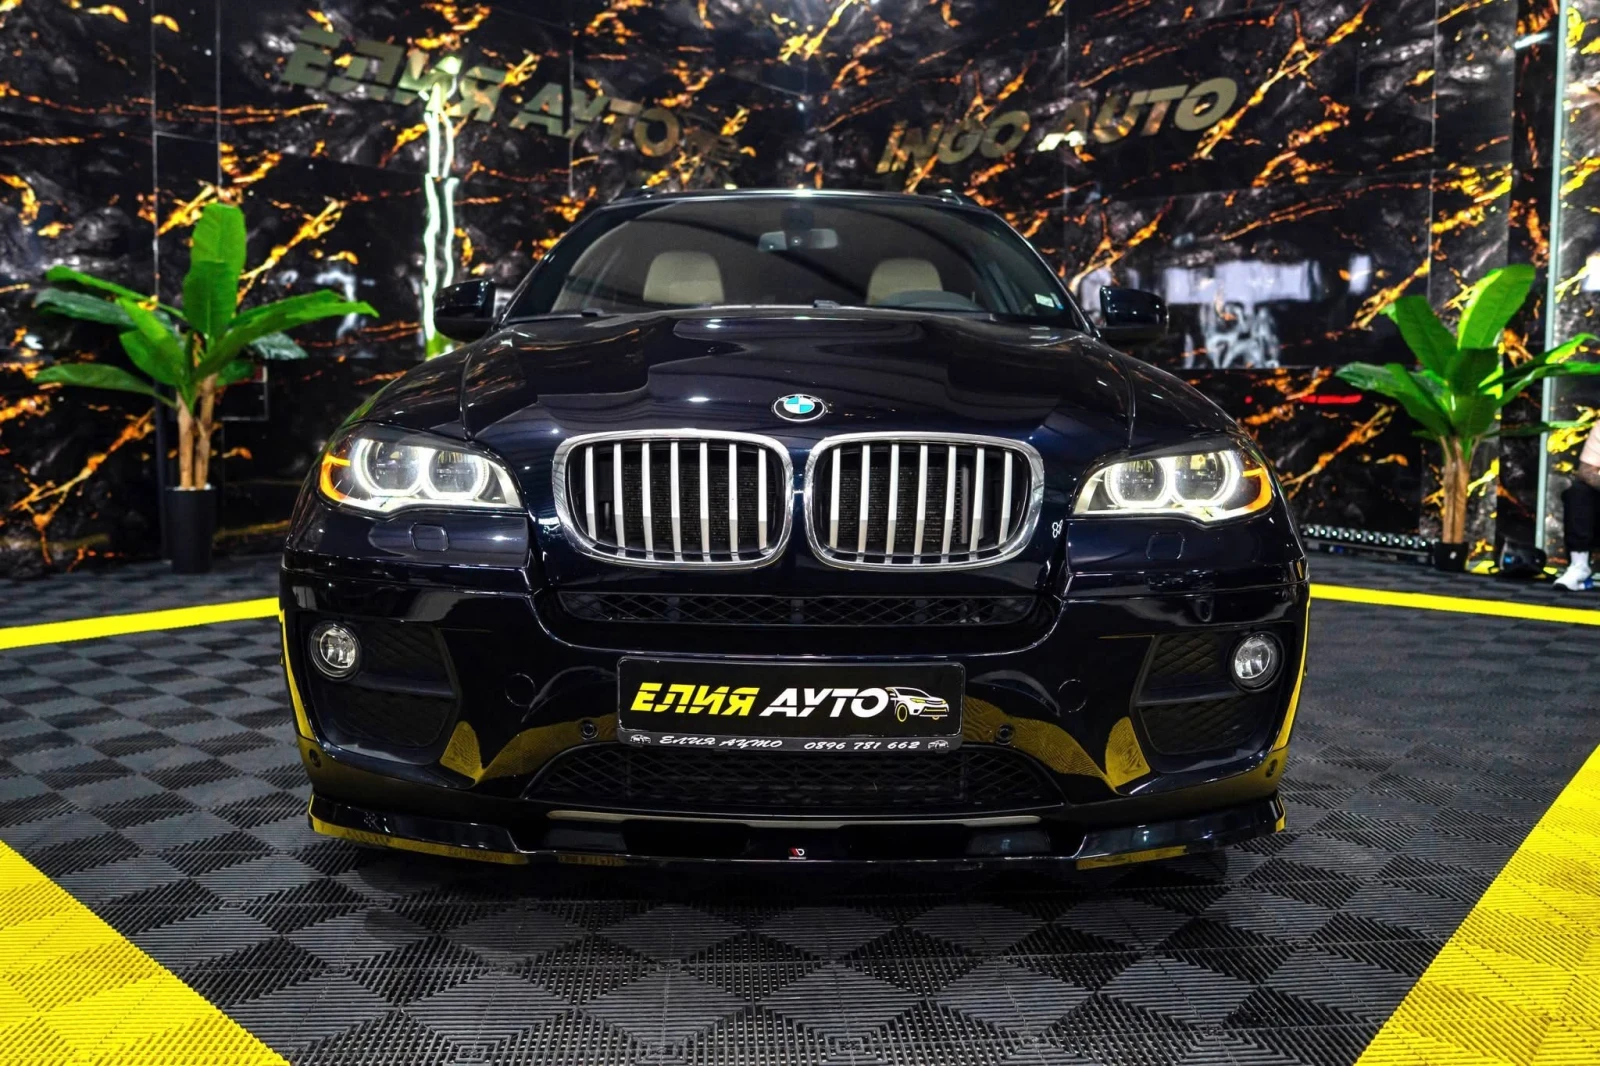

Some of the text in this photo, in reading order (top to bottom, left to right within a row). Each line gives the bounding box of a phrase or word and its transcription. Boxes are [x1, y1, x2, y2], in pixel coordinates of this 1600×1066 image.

[875, 77, 1238, 174] INGO AUTO
[630, 682, 889, 718] ЕЛИЯ АУТО
[803, 741, 847, 750] 0896
[853, 741, 882, 750] 781
